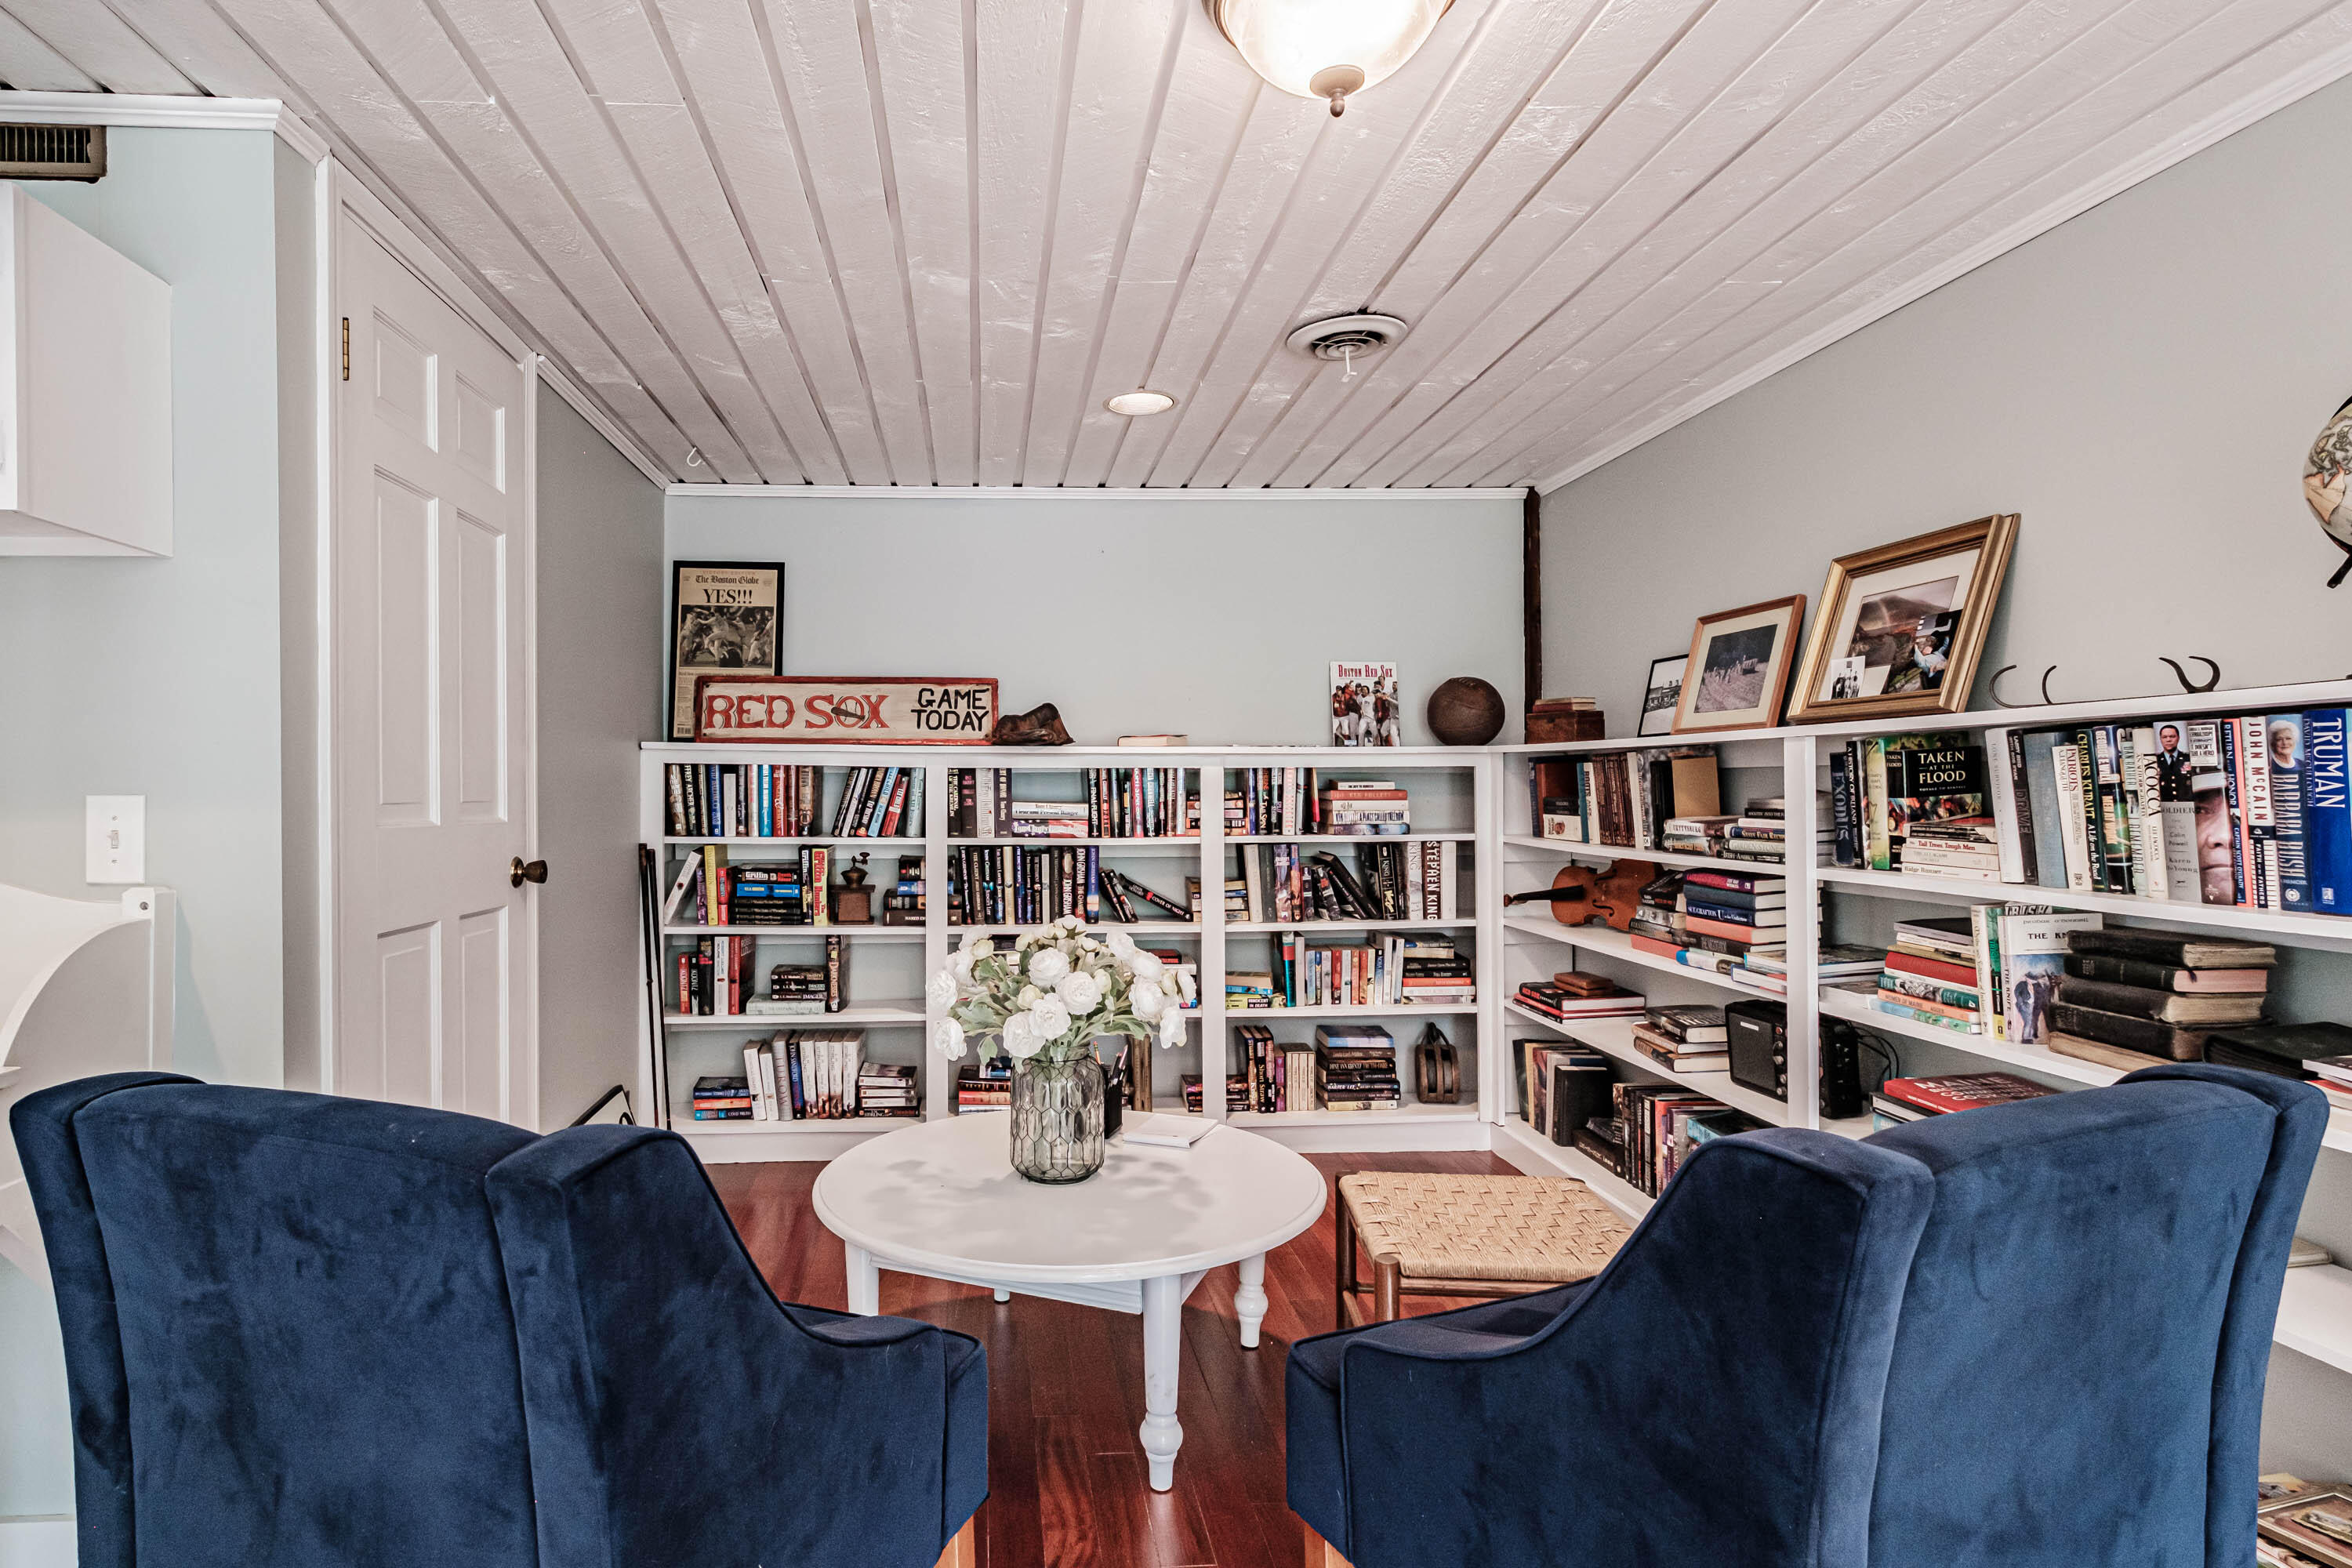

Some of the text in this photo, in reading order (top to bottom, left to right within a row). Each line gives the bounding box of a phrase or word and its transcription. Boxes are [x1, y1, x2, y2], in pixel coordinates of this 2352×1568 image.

[702, 589, 753, 604] YES!!!
[1338, 665, 1392, 677] BOSTON RED SOX
[917, 688, 989, 711] GAME
[704, 695, 889, 729] RED SOX
[911, 709, 989, 732] TODAY
[2303, 718, 2311, 745] DAVID
[1918, 751, 1965, 764] TAKEN
[2223, 724, 2236, 805] RETURN HONOR
[2312, 717, 2346, 808] TRUMAN
[684, 765, 692, 782] FFREY
[1919, 771, 1966, 784] FLOOD
[2066, 748, 2078, 792] PATRIOTS
[2077, 733, 2095, 818] CHARLES KURALT
[2249, 722, 2267, 820] JOHN McCAIN
[883, 781, 892, 796] CHILD
[1849, 783, 1855, 794] OF
[2143, 753, 2161, 816] IACOCCA
[1832, 771, 1849, 840] EXODUS
[2016, 789, 2031, 833] DRIVE
[2102, 796, 2114, 811] MEN
[2123, 746, 2144, 874] DAN RATHER REMEMBER
[1363, 812, 1374, 821] PLACE
[2273, 773, 2305, 877] BARBARA BUSH
[1673, 825, 1701, 833] GETTYSBURG
[1076, 848, 1086, 862] JOHN
[2089, 843, 2096, 851] on
[1076, 862, 1086, 884] GRISHAM
[1382, 860, 1391, 877] KING
[2092, 863, 2101, 880] Road
[814, 851, 826, 916] Griffin Hunters
[1427, 841, 1438, 920] STEPHEN KING
[1063, 879, 1072, 914] JOHN GRISHAM
[1152, 895, 1166, 906] COVER
[1172, 906, 1185, 916] NIGHT
[1697, 908, 1717, 916] GRAFTON
[1718, 909, 1725, 920] U
[2005, 906, 2049, 916] IRISH
[829, 962, 840, 997] DARKNESSES
[1885, 995, 1901, 1004] WOMEN
[1908, 1000, 1922, 1008] MAINE
[775, 1058, 789, 1105] TUROW
[1913, 1076, 2013, 1089] MAINE
